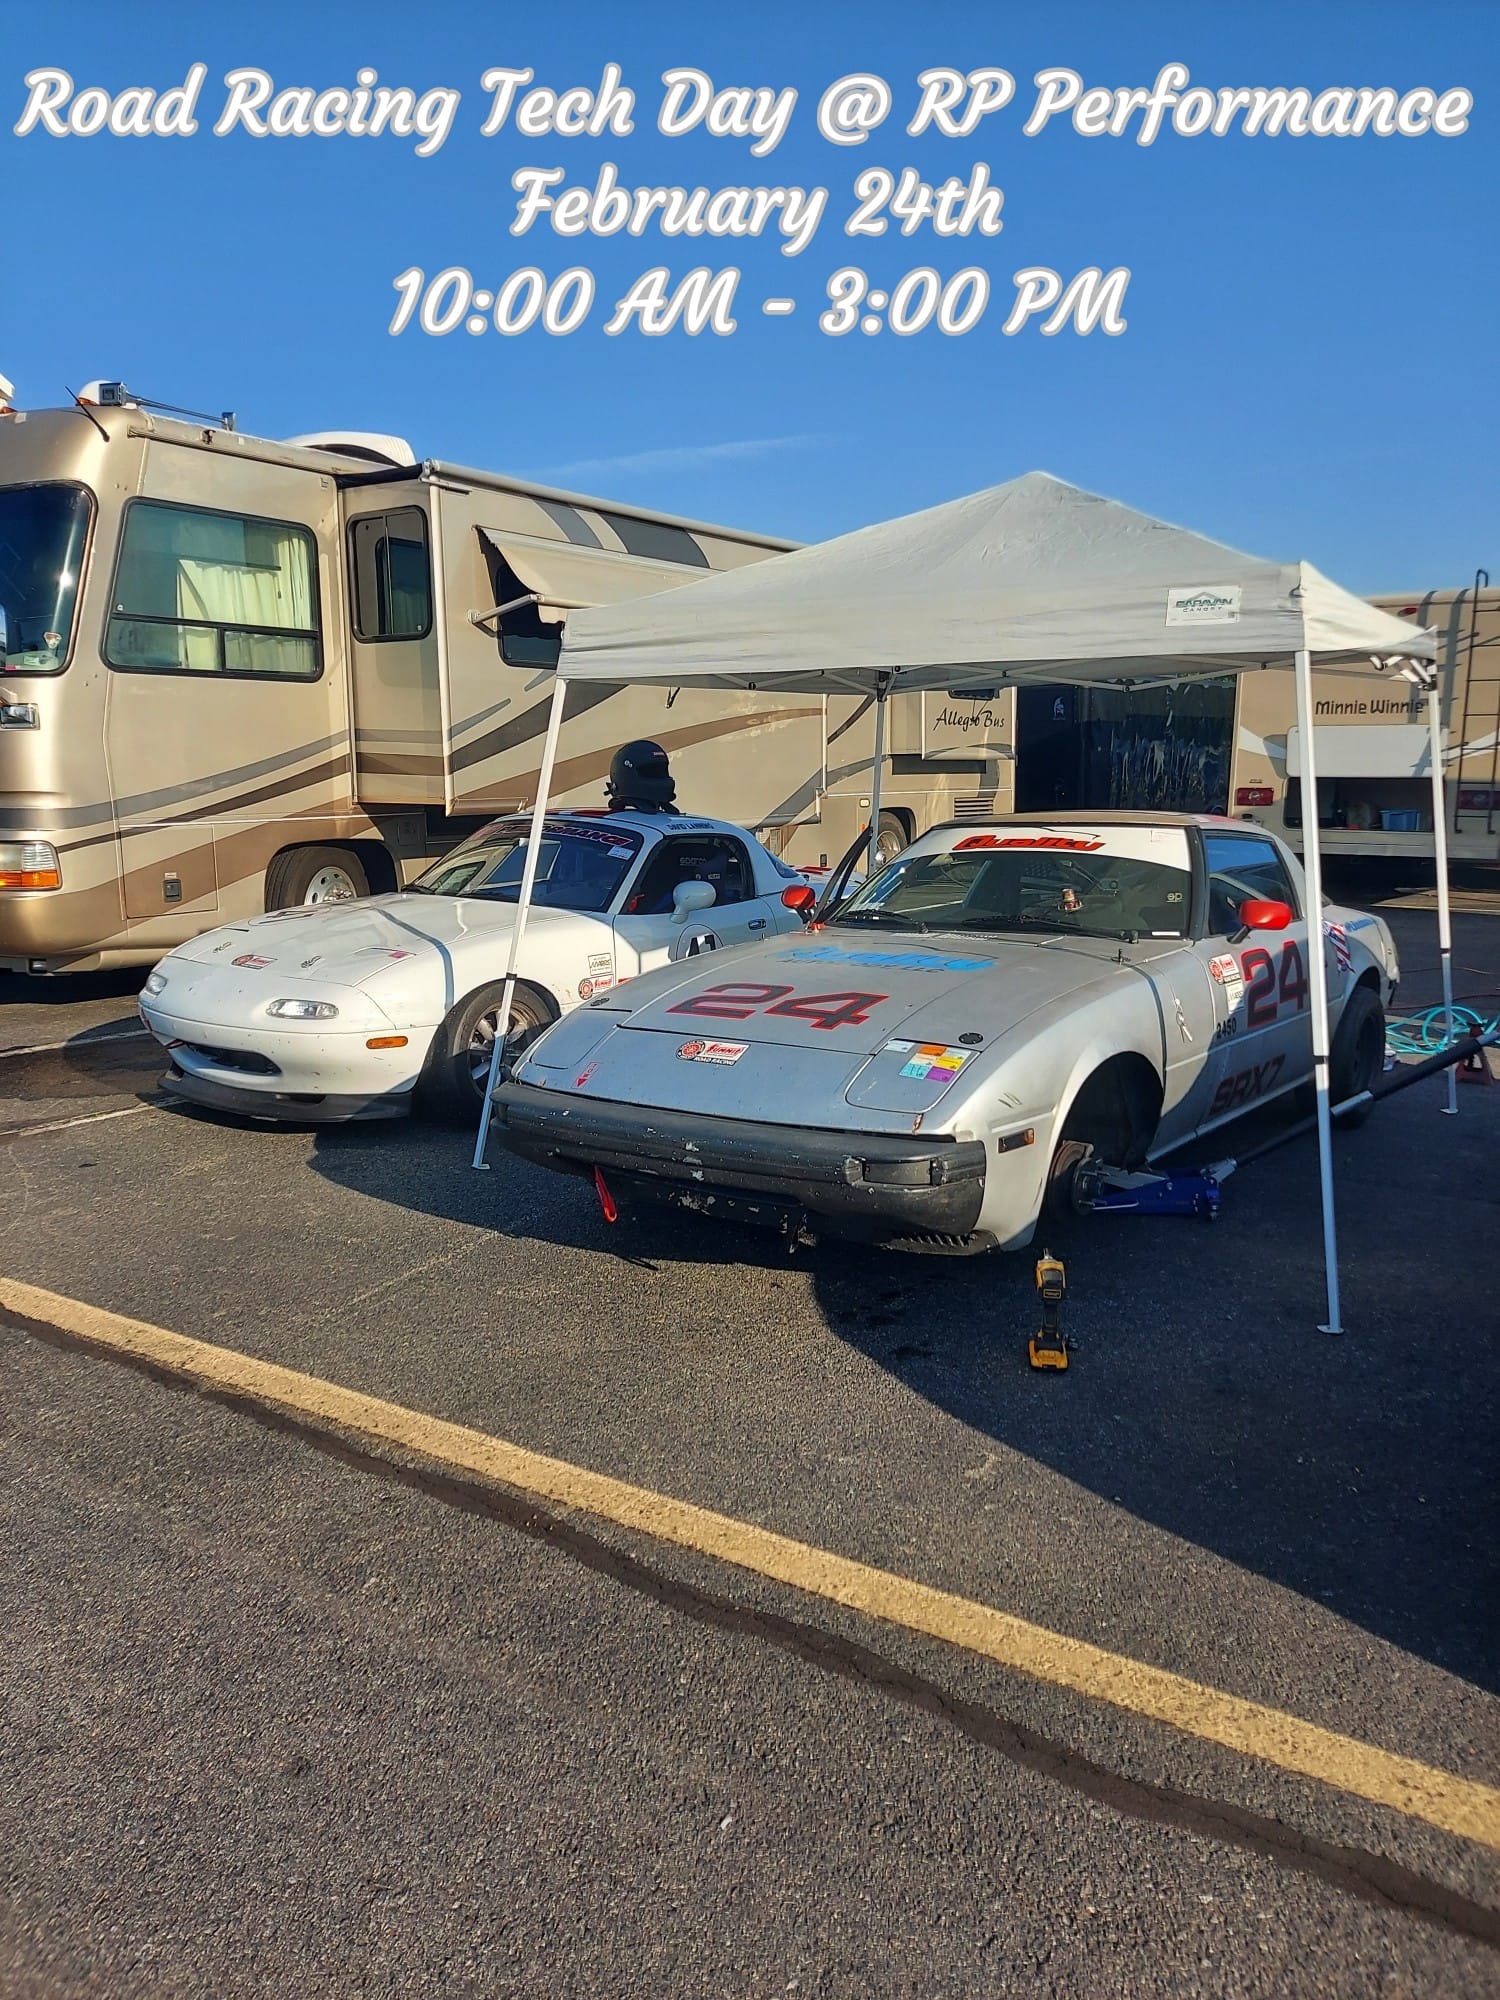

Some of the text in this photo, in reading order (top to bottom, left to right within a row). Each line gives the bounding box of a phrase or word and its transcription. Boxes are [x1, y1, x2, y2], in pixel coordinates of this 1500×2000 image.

[1175, 598, 1233, 608] CARAVAN
[933, 707, 1005, 732] Allegro Bus
[1315, 699, 1424, 715] Minnie Winnie
[1240, 938, 1308, 1031] 24
[665, 983, 890, 1031] 24
